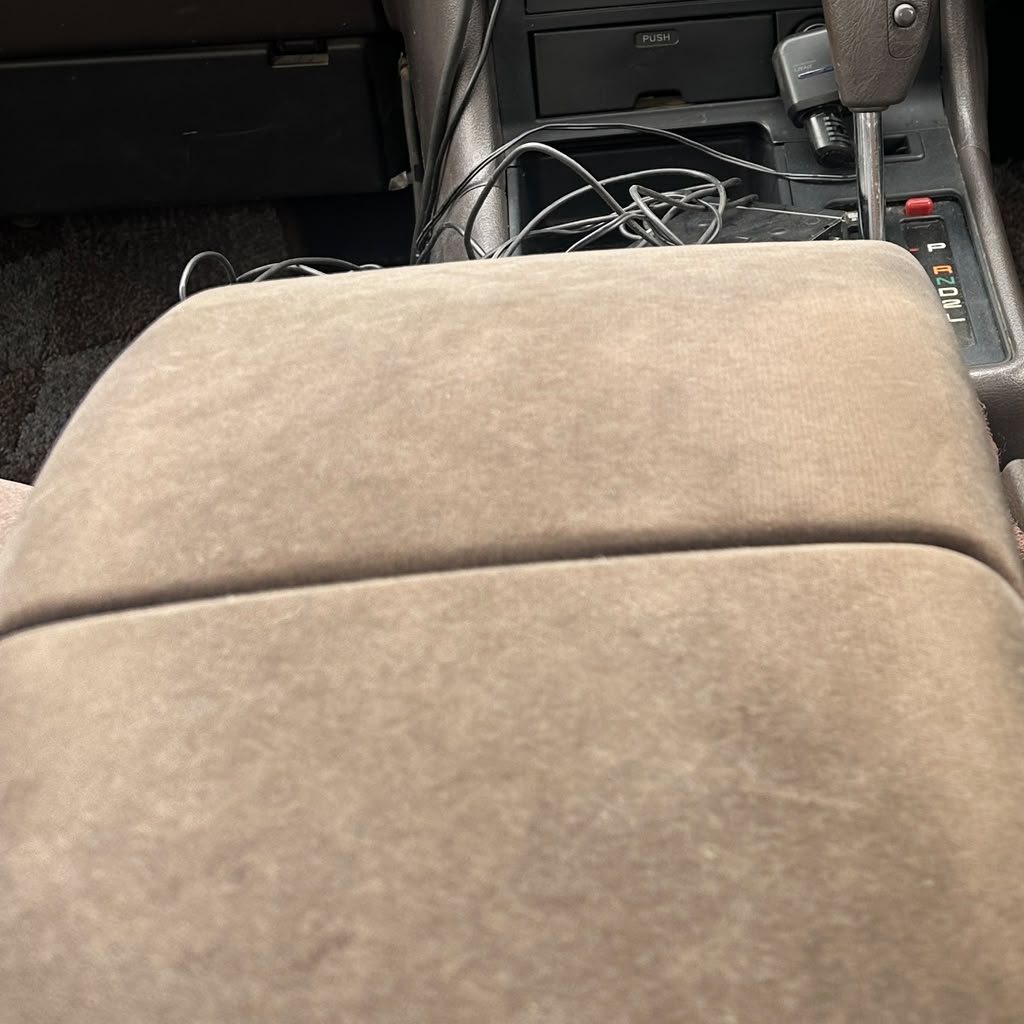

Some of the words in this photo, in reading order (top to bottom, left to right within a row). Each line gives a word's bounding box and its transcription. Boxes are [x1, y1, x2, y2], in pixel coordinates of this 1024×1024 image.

[642, 32, 671, 43] PUSH
[927, 242, 946, 252] P
[932, 265, 953, 274] R
[936, 276, 956, 285] N
[938, 287, 959, 297] D
[946, 313, 966, 322] L
